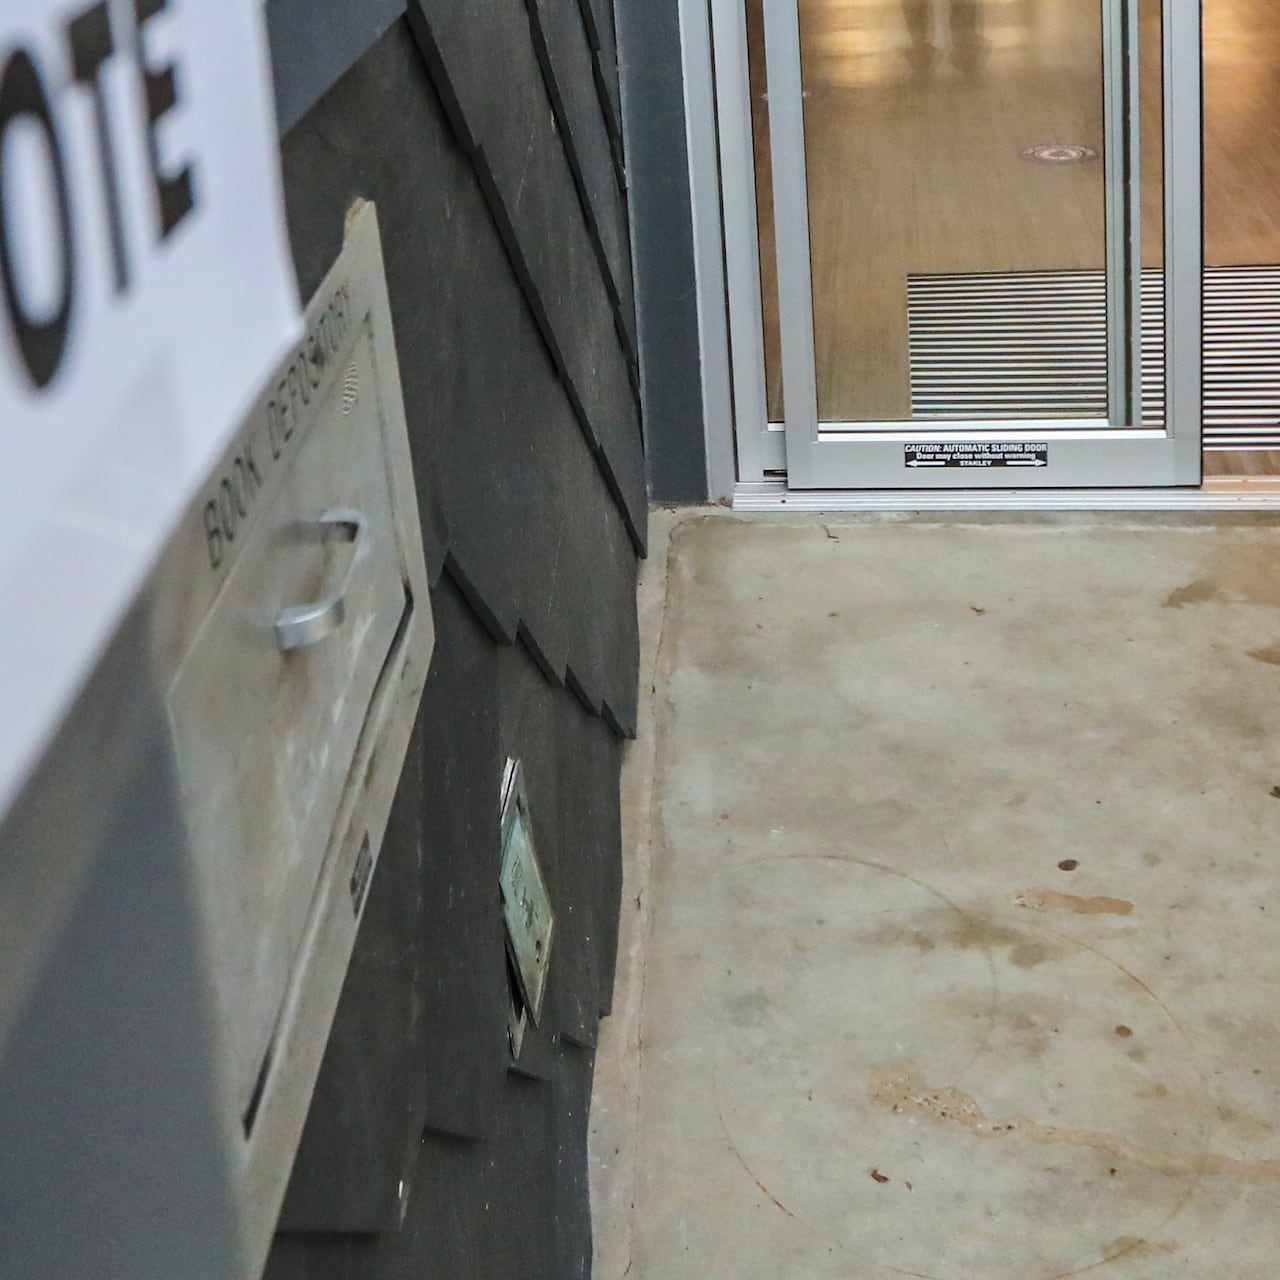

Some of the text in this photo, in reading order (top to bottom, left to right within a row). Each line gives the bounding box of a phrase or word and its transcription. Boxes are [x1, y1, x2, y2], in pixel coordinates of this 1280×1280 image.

[943, 443, 990, 452] AUTOMATIC
[991, 443, 1023, 452] SLIDING
[1024, 442, 1047, 452] DOOR
